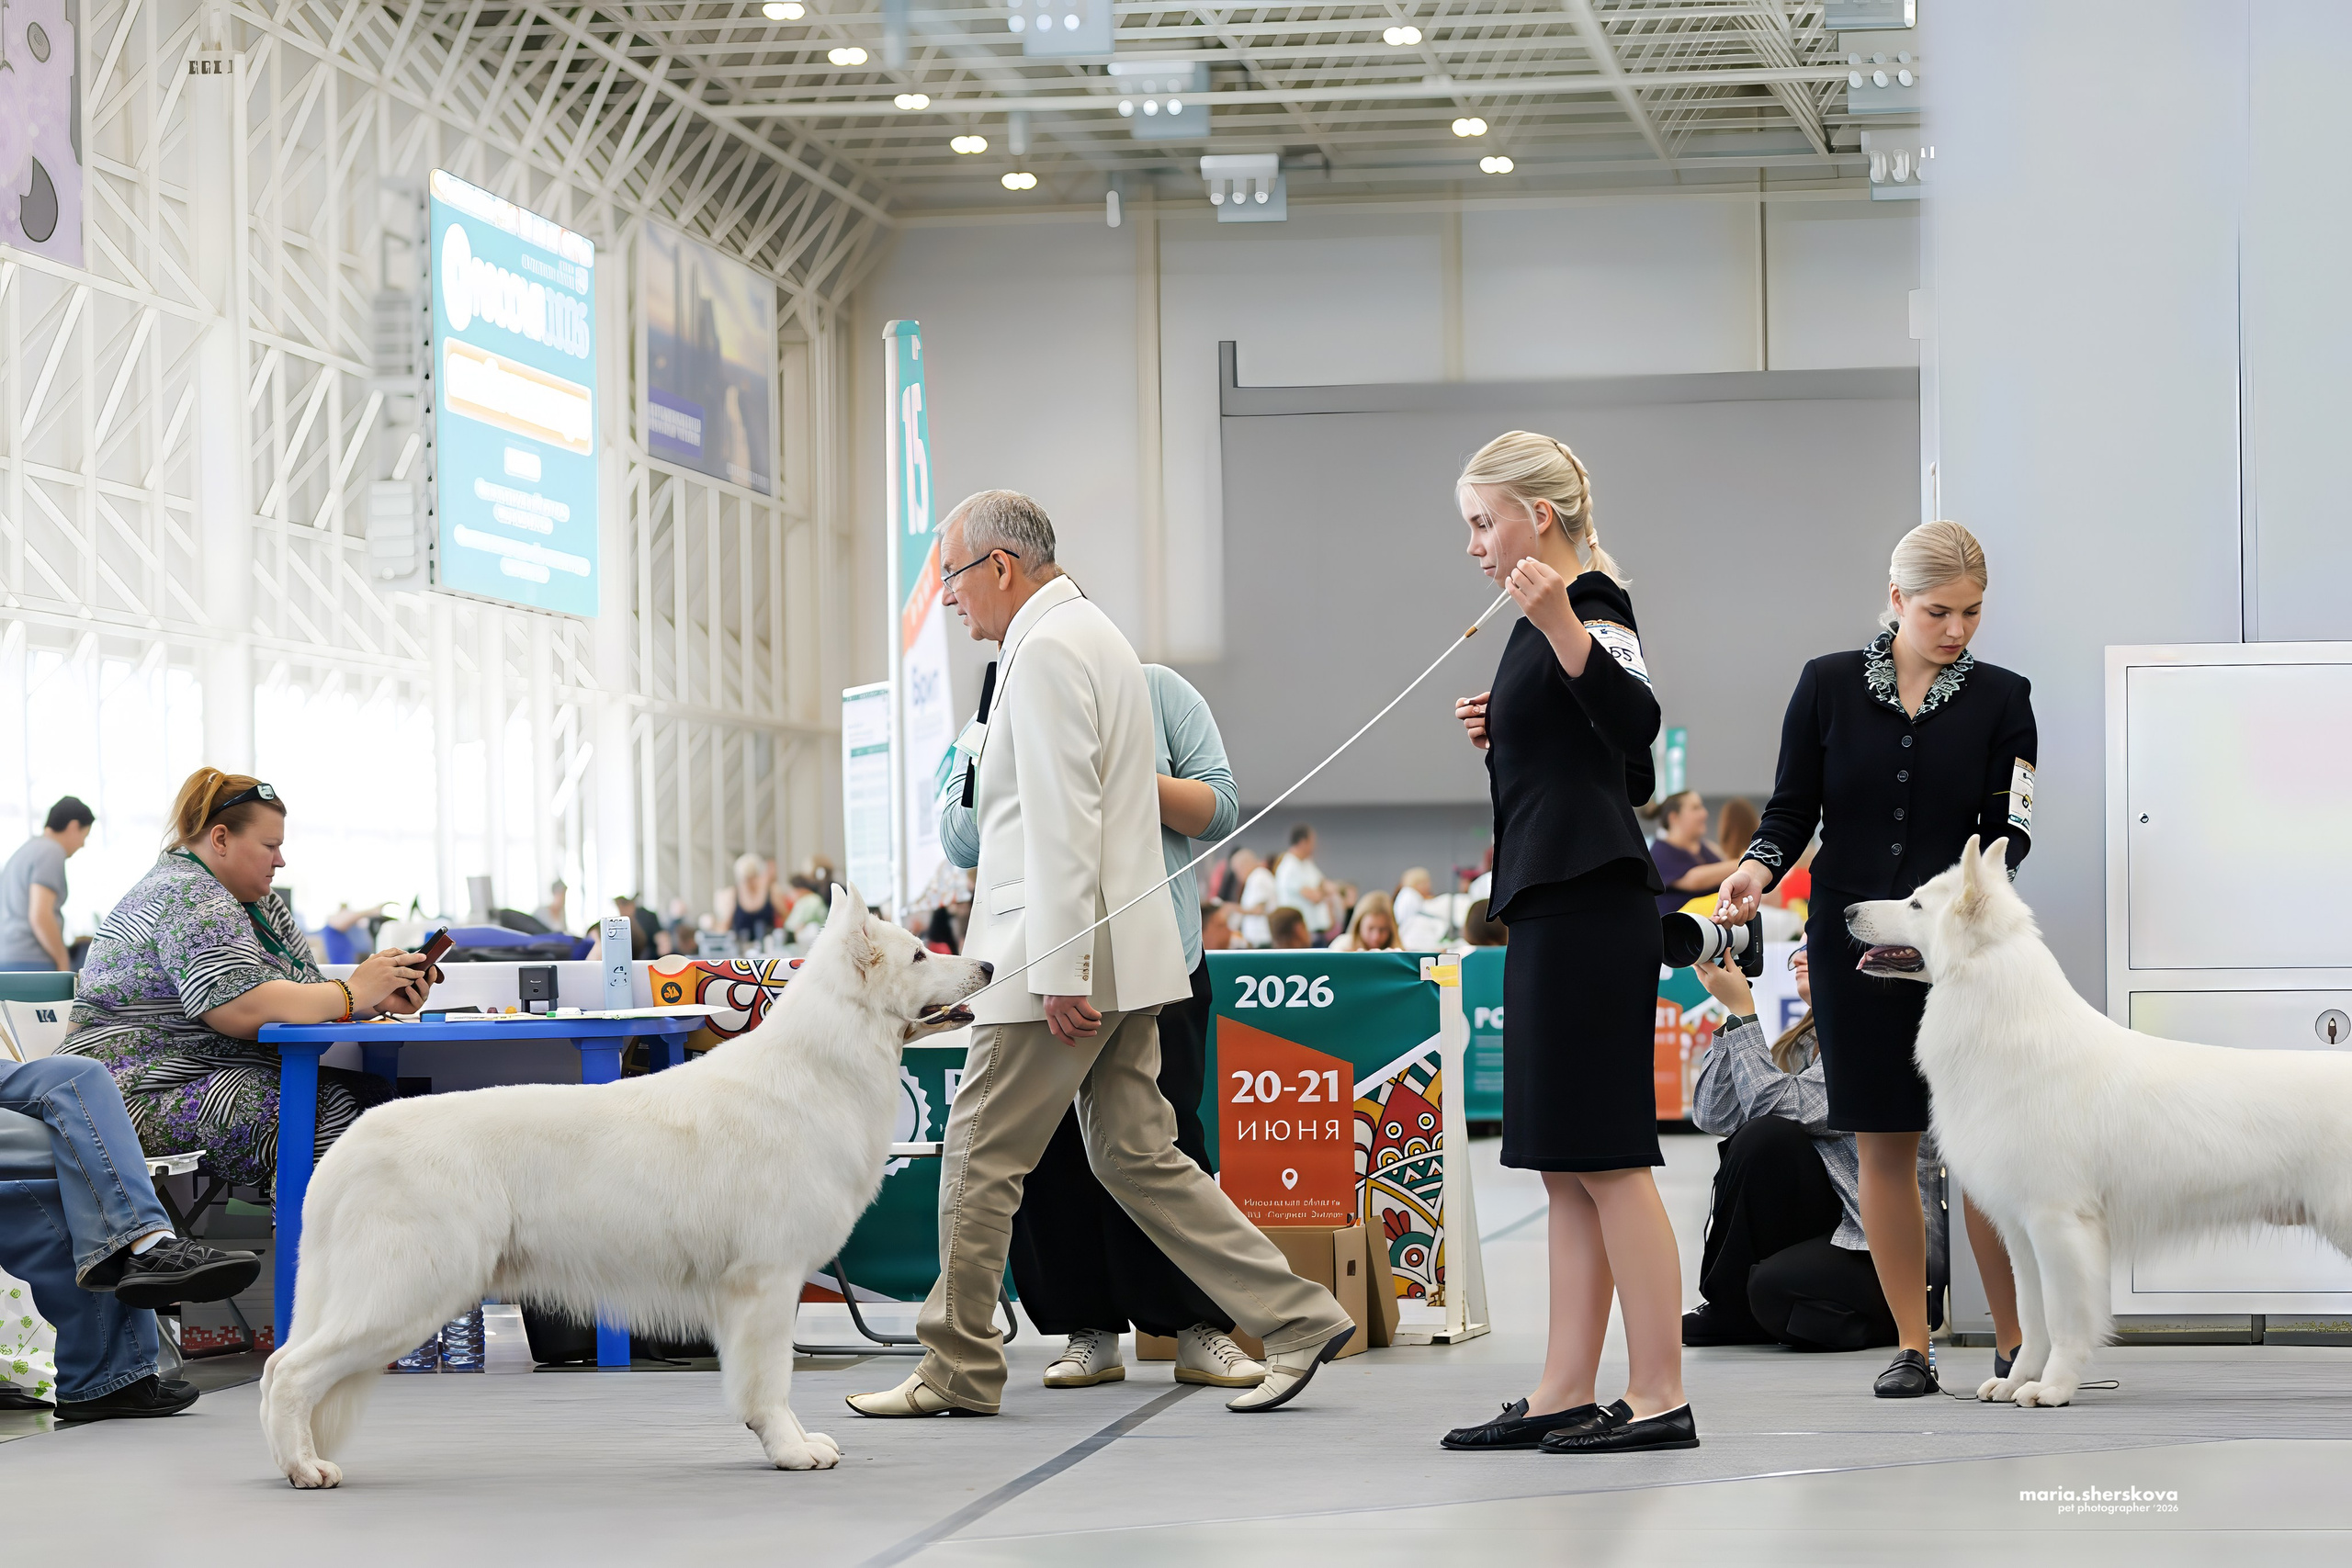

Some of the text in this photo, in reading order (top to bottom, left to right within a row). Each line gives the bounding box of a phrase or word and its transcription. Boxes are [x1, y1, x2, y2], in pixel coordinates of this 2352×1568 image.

[1235, 975, 1335, 1009] 2026
[1231, 1069, 1339, 1103] 20-21
[1238, 1120, 1340, 1141] ИЮНЯ
